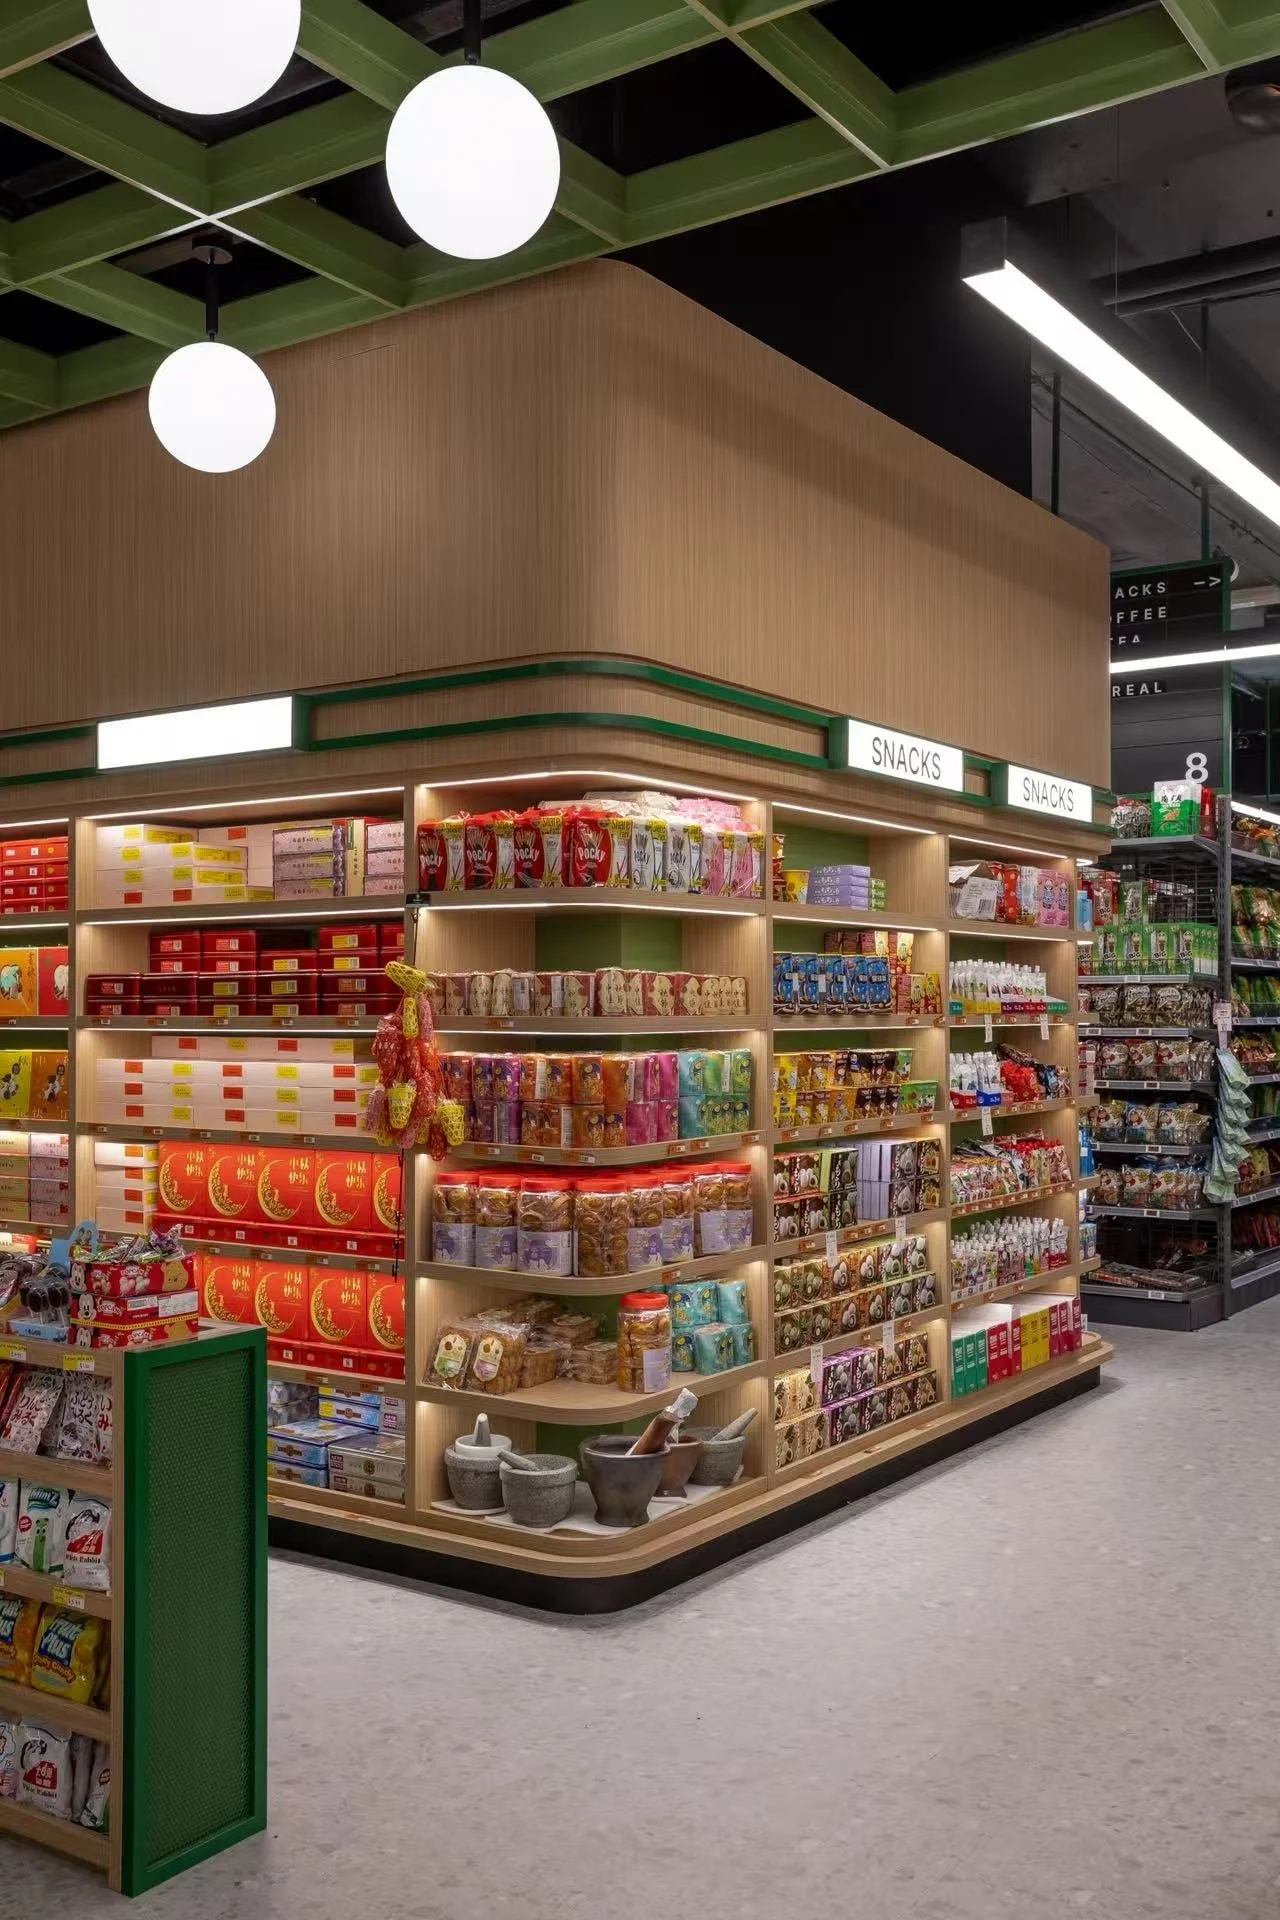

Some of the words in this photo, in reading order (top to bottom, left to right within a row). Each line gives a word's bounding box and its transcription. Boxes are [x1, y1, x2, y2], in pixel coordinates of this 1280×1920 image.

[1109, 606, 1167, 624] FFEE
[1109, 634, 1141, 646] EA
[871, 736, 942, 781] SNACKS
[1185, 752, 1209, 784] 8
[1022, 776, 1075, 813] SNACKS
[466, 847, 493, 864] POCKY
[514, 847, 540, 862] POCKY
[577, 846, 606, 863] POCKY
